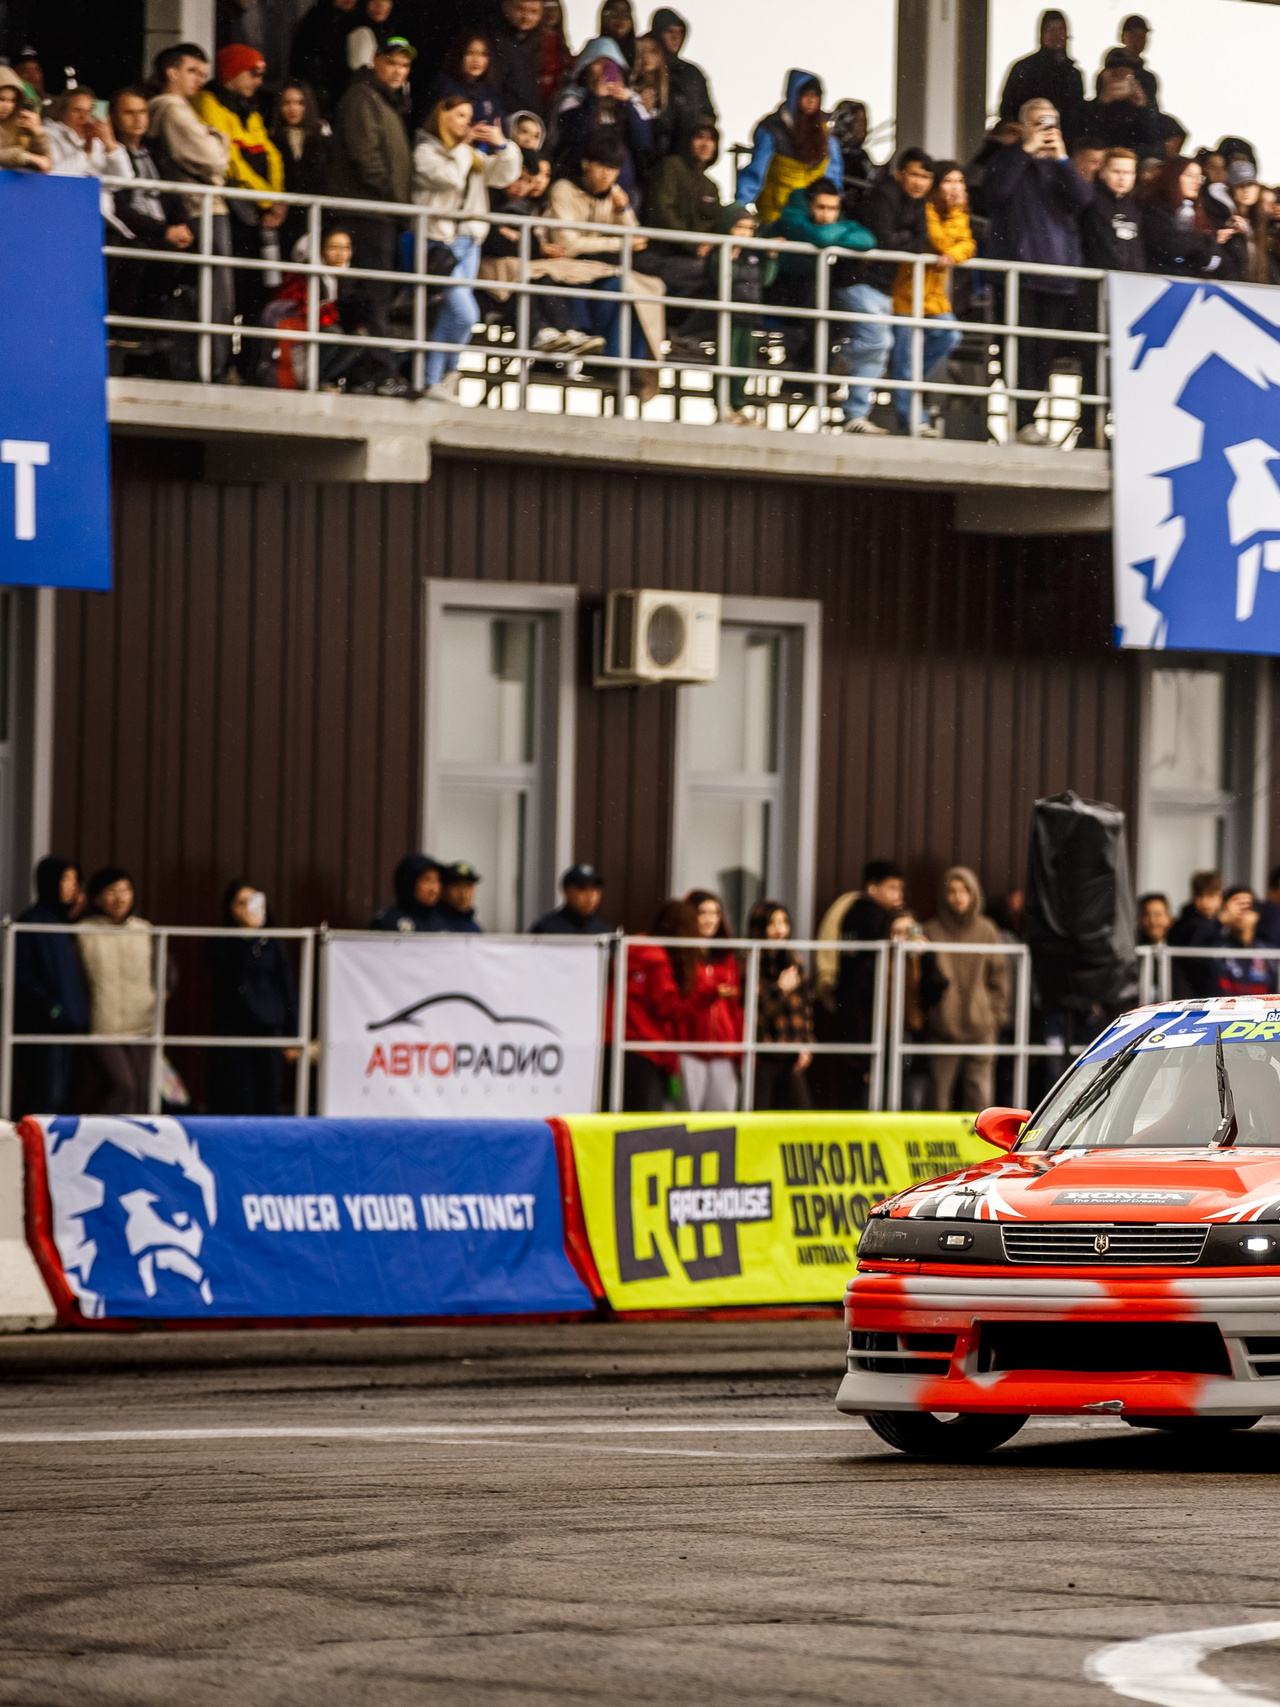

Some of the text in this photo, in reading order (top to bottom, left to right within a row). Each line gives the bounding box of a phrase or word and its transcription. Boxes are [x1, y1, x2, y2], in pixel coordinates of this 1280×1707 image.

[780, 1141, 888, 1187] ШКОЛА
[242, 1193, 536, 1231] POWER YOUR INSTINCT
[669, 1186, 771, 1227] RACEHOUSE
[1064, 1192, 1185, 1200] HONDA
